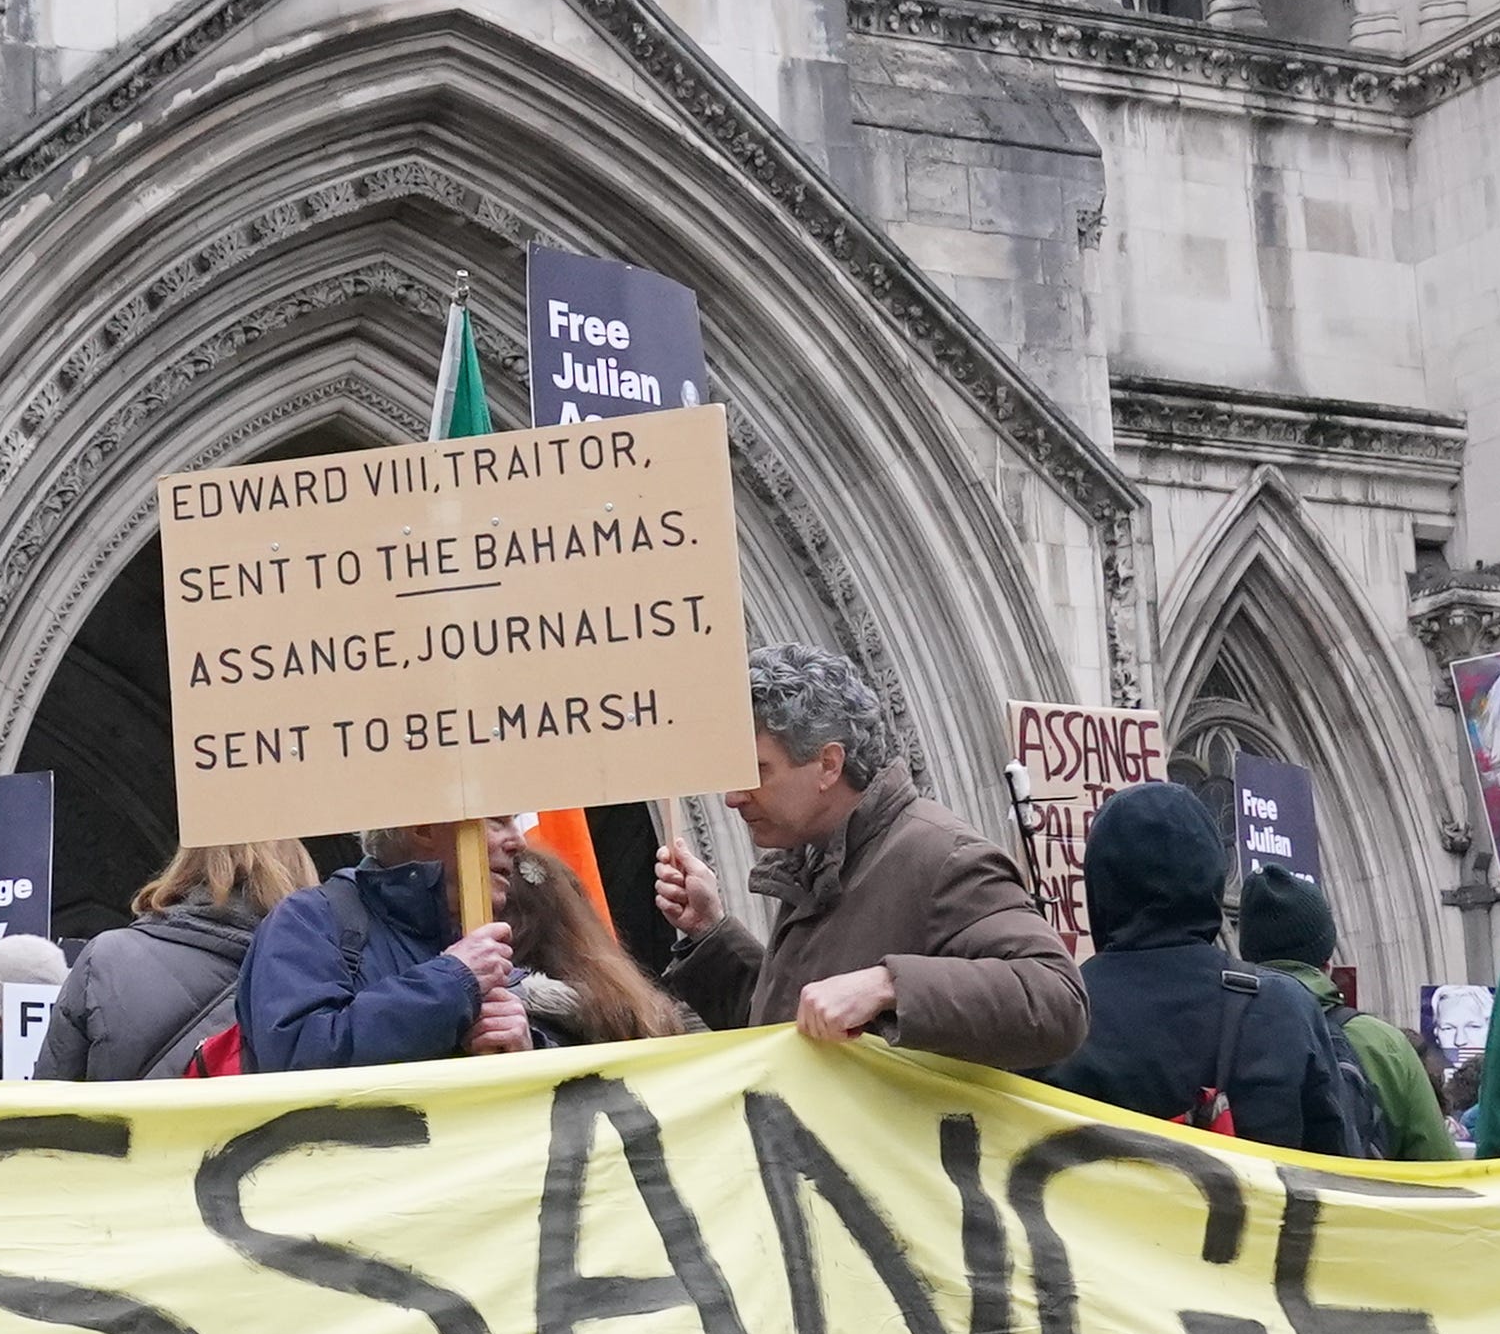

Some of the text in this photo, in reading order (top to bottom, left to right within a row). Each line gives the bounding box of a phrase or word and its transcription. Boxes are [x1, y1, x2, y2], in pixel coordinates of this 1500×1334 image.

[548, 299, 630, 350] Free
[552, 352, 662, 406] Julian
[172, 466, 348, 521] EDWARD
[179, 510, 699, 603] SENT TO THE BAHAMAS.
[193, 689, 674, 770] SENT TO BELMARSH.
[1019, 706, 1164, 783] ASSANGE
[1242, 788, 1278, 821] Free
[1246, 823, 1292, 858] Julian
